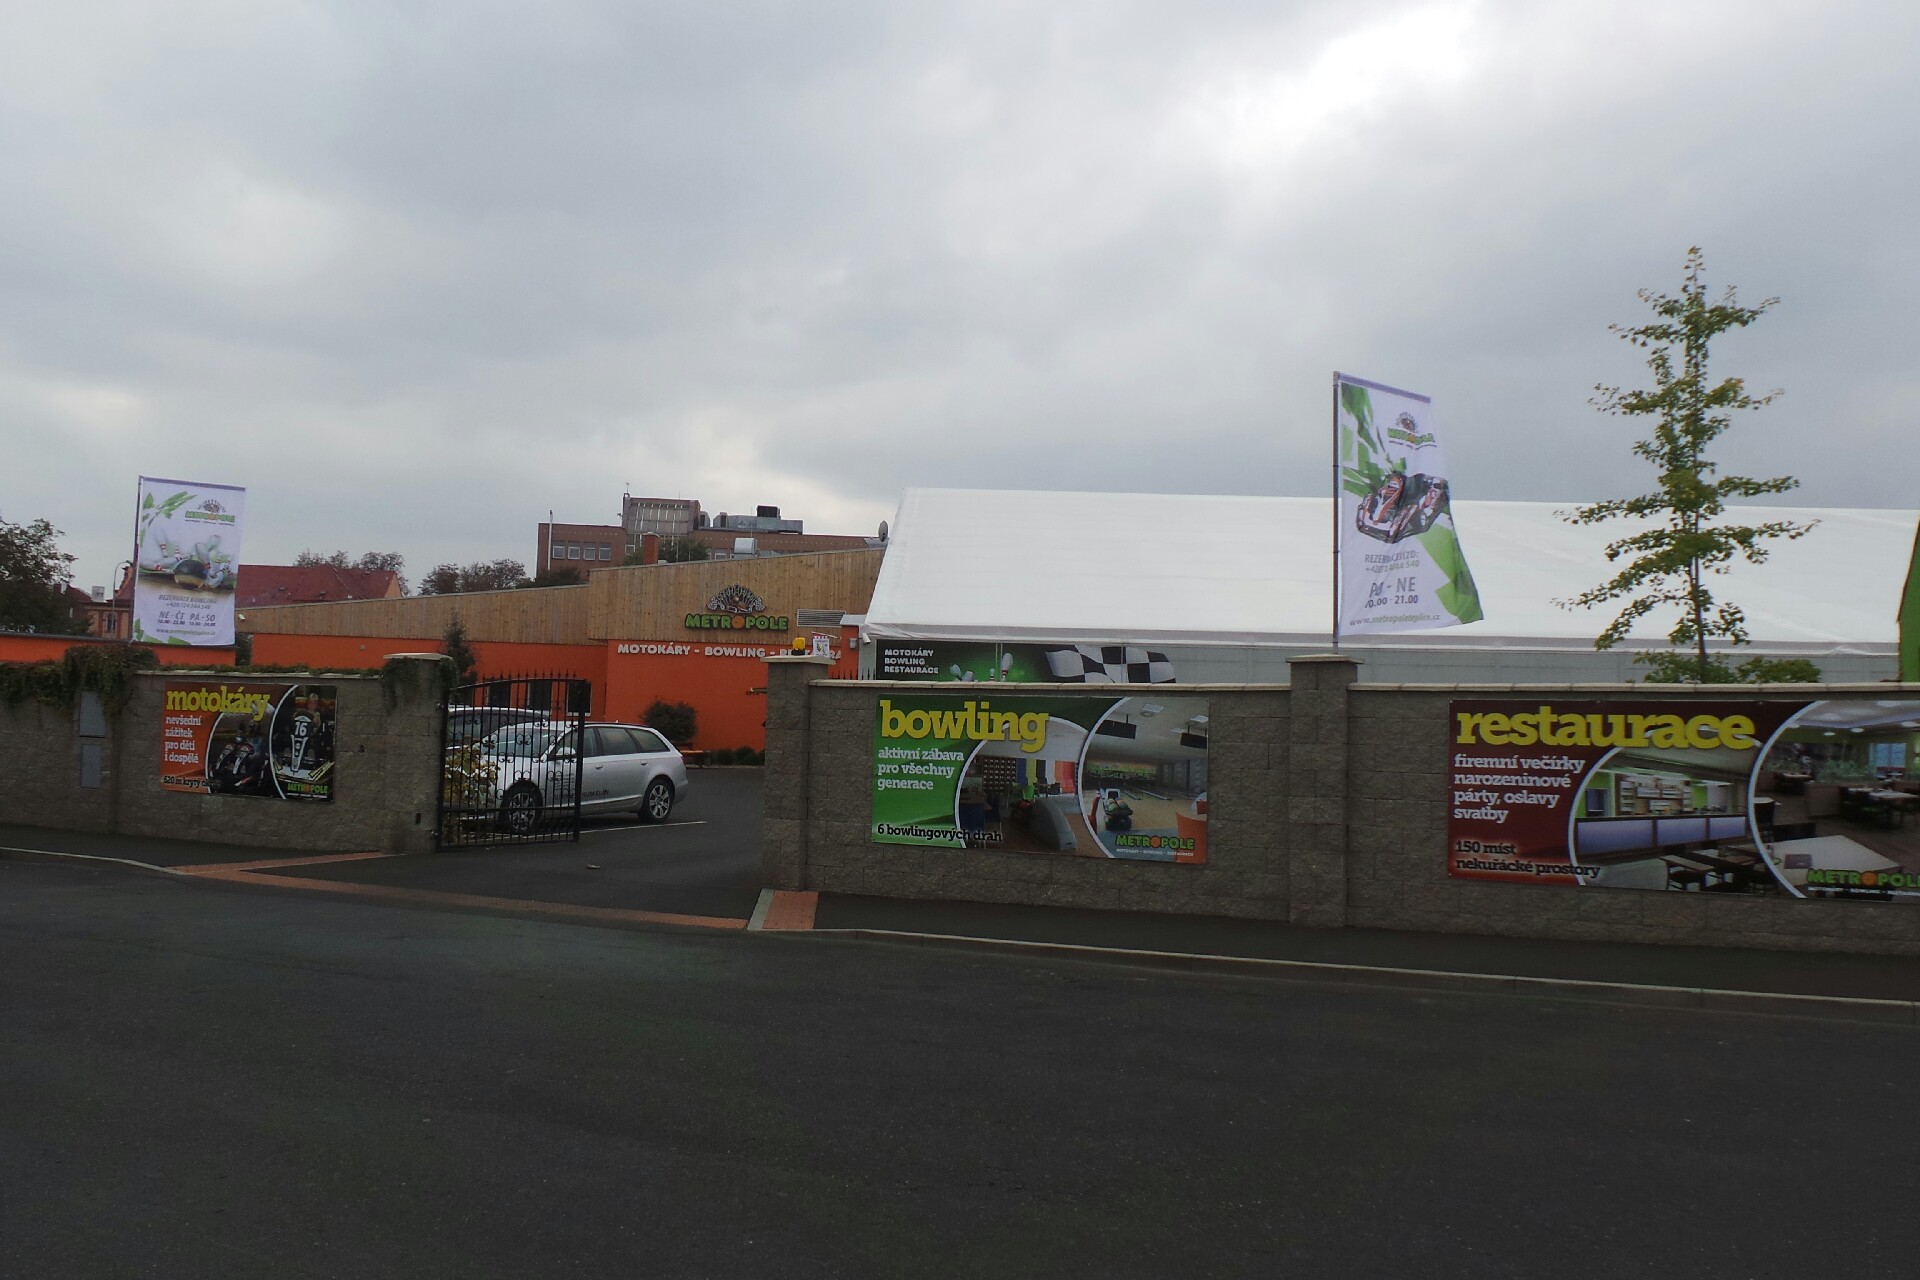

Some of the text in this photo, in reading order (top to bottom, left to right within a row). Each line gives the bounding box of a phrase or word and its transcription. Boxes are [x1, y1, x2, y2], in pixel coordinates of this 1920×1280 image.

[1397, 577, 1416, 592] NE
[1395, 595, 1418, 604] 21.00
[159, 611, 170, 619] NE
[685, 614, 788, 632] METROPOLE
[617, 642, 690, 655] MOTOKÁRY
[704, 646, 765, 658] BOWLING
[884, 647, 934, 657] MOTOKÁRY
[884, 657, 926, 665] BOWLING
[884, 665, 939, 674] RESTAURACE
[166, 685, 271, 722] motokáry
[295, 722, 308, 737] 16
[879, 699, 1049, 753] bowling
[1456, 705, 1756, 749] restaurace
[164, 740, 195, 752] pro děti
[164, 751, 199, 765] i dospělé
[878, 747, 964, 761] aktivní zábava
[877, 762, 954, 779] pro všechny
[1454, 754, 1585, 774] firemní večírky
[877, 778, 934, 791] generace
[1454, 773, 1572, 788] narozeninové
[1453, 788, 1560, 809] párty, oslavy
[1453, 806, 1509, 824] svatby
[877, 823, 1003, 842] 6 bowlingových drah
[1116, 834, 1195, 850] METROPOLE
[1456, 840, 1517, 855] 150 míst
[1456, 858, 1600, 878] nekuřácké prostory
